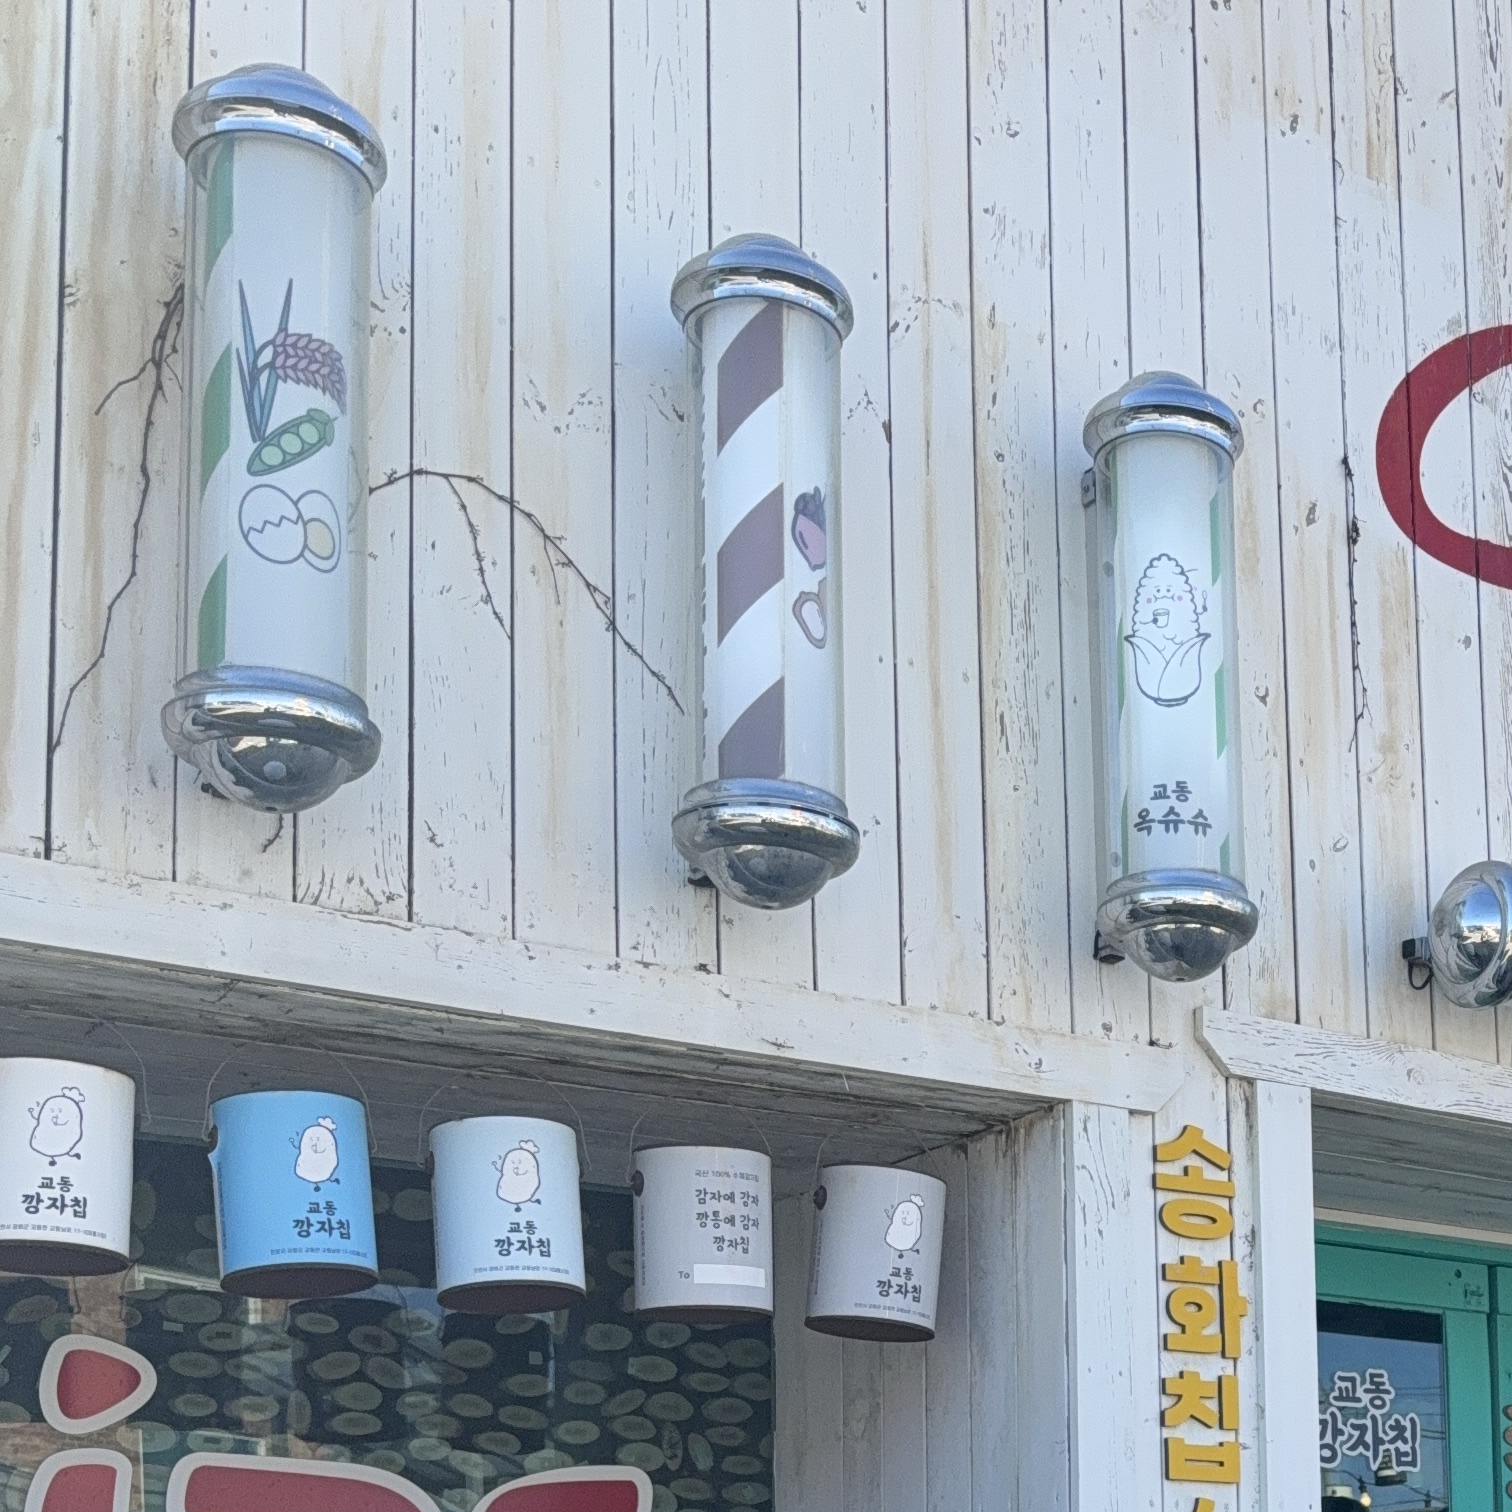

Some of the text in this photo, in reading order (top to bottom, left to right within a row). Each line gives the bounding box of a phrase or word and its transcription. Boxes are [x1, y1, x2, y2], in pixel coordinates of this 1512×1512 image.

[1149, 781, 1193, 802] 교동
[1133, 806, 1213, 837] 옥슈슈
[37, 1175, 74, 1193] 교동
[21, 1192, 88, 1219] 깡자칩
[695, 1188, 736, 1205] 감자에
[306, 1201, 338, 1216] 교동
[292, 1217, 351, 1240] 깡자칩
[507, 1221, 538, 1235] 교동
[494, 1236, 551, 1258] 깡자칩
[712, 1235, 750, 1254] 깡자칩
[678, 1270, 690, 1280] To
[889, 1266, 914, 1281] 교동
[875, 1279, 922, 1303] 깡자칩
[1331, 1370, 1394, 1412] 교동
